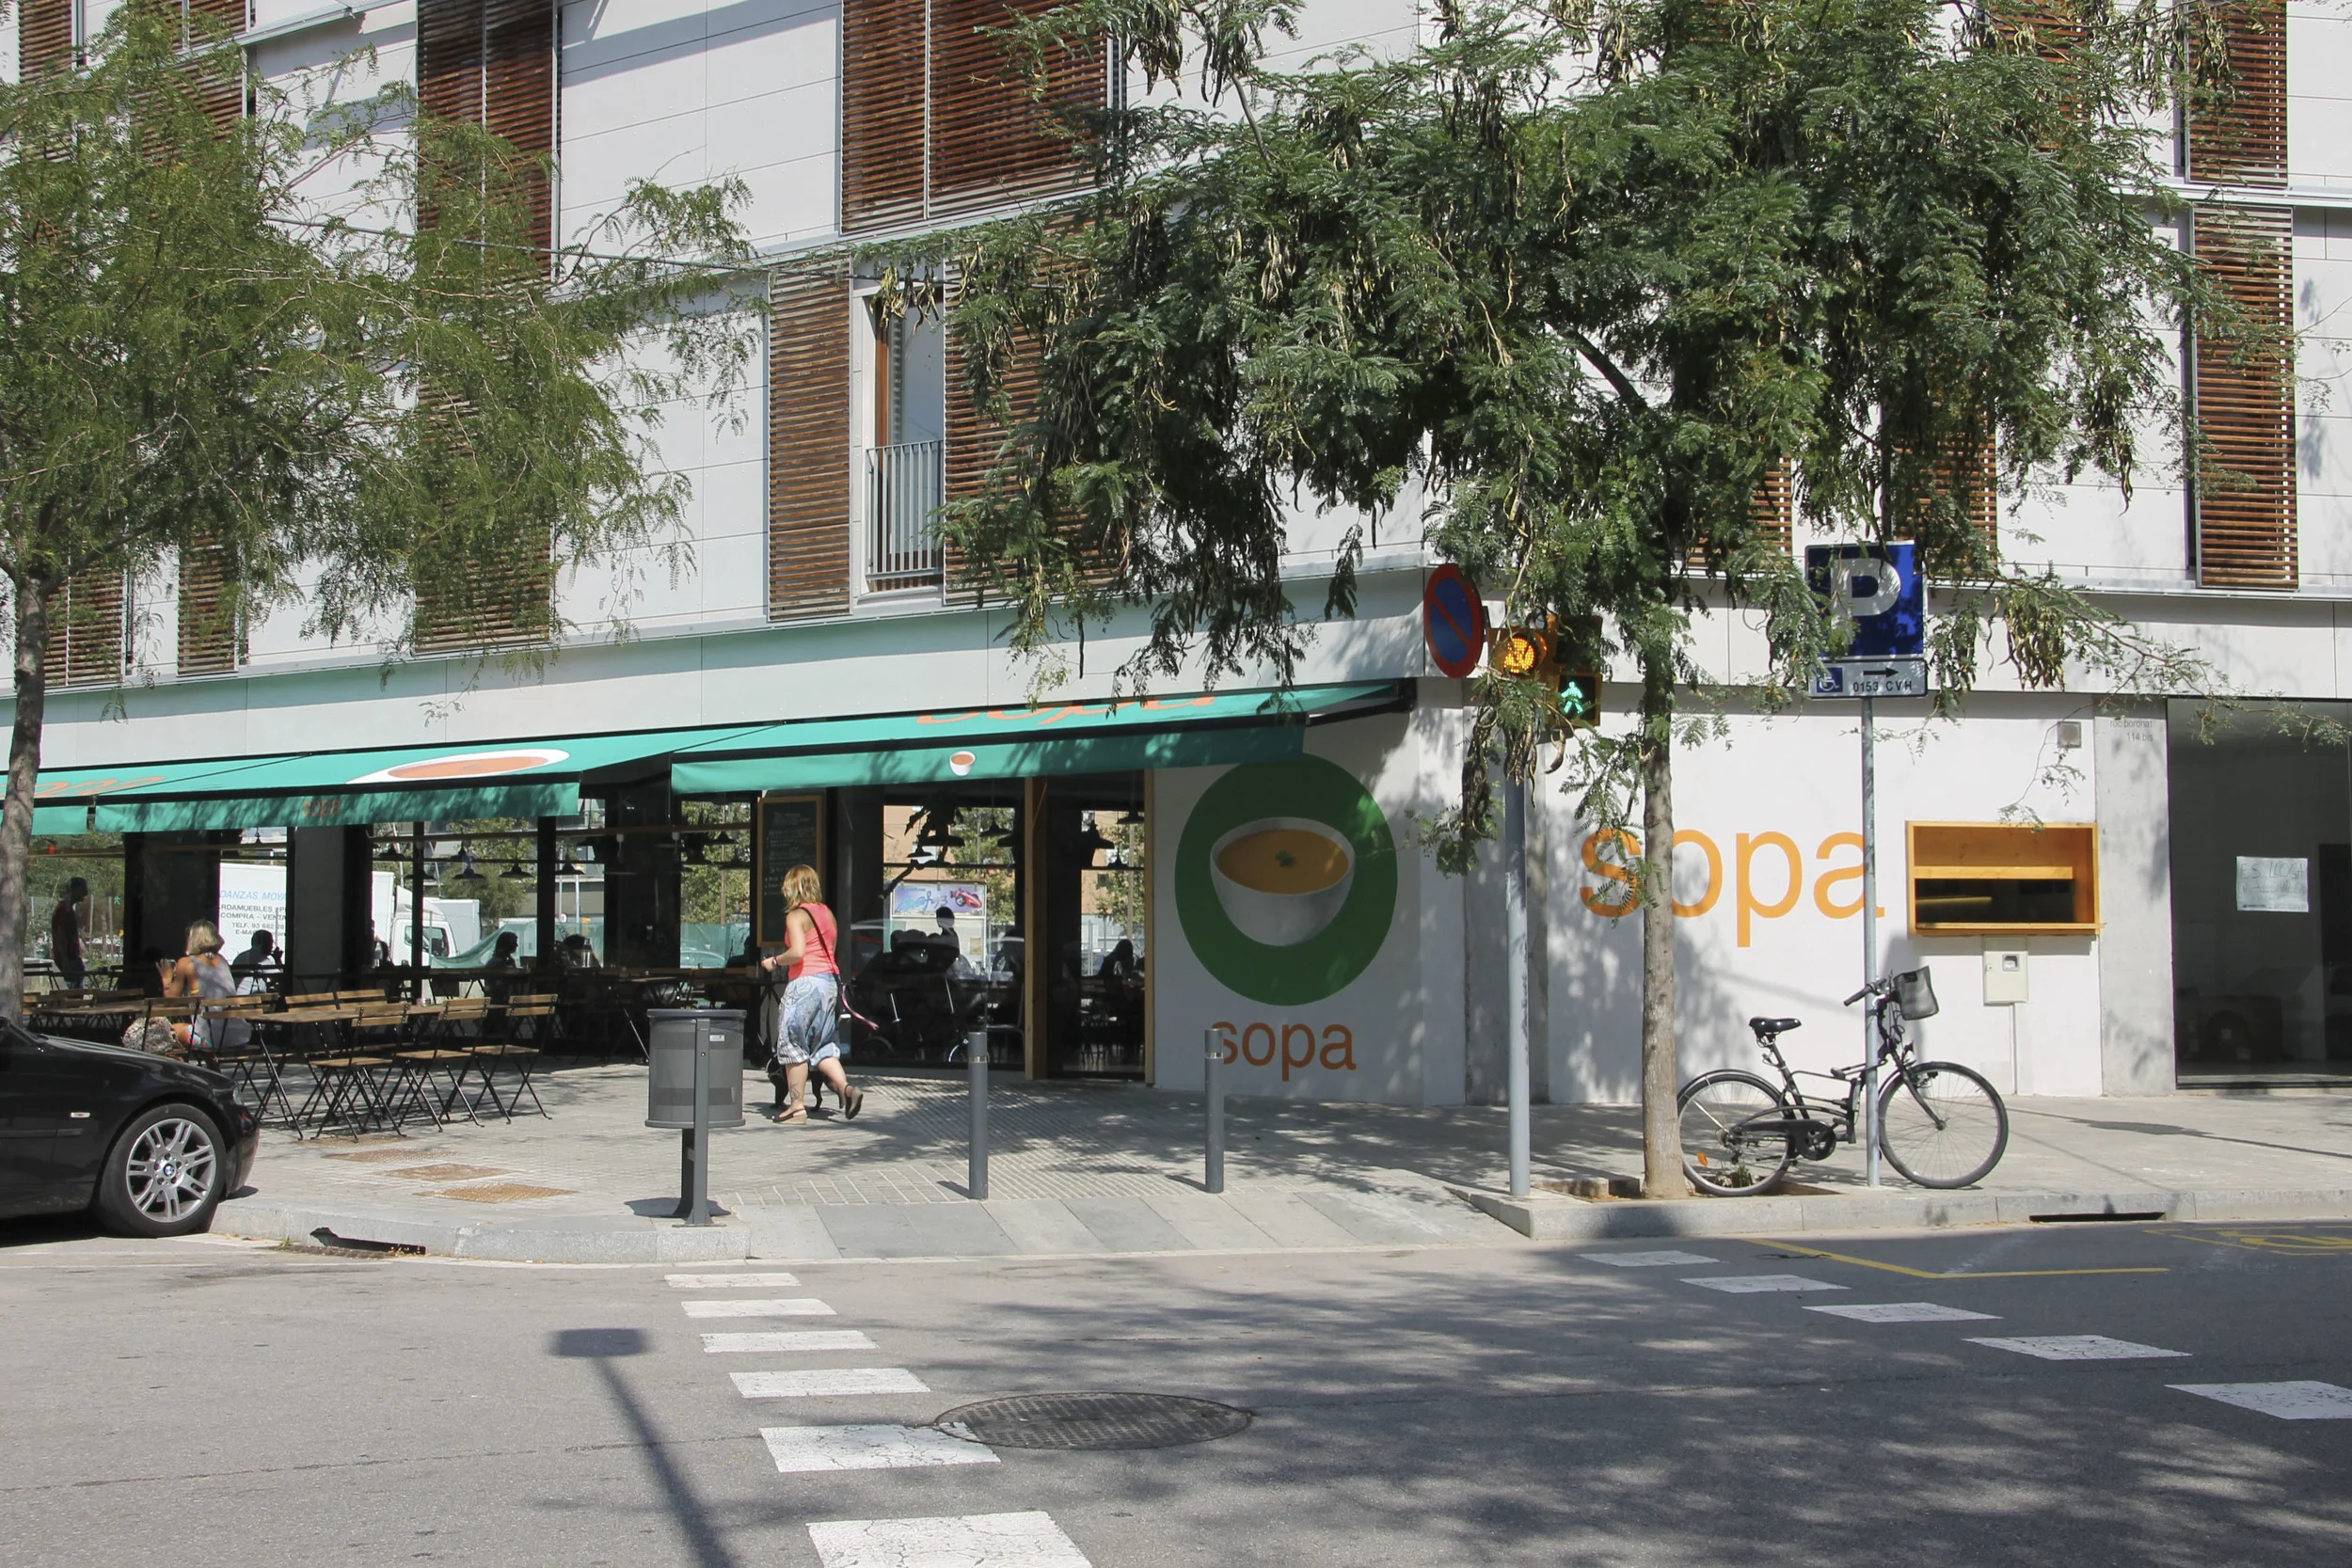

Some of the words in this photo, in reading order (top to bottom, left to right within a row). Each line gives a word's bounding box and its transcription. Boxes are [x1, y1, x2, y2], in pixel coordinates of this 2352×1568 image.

[1830, 557, 1901, 645] P
[1852, 681, 1879, 692] 0153
[1885, 680, 1913, 691] CVH
[302, 800, 342, 821] sopa
[1579, 828, 1885, 947] sopa
[1212, 1021, 1358, 1082] sopa
